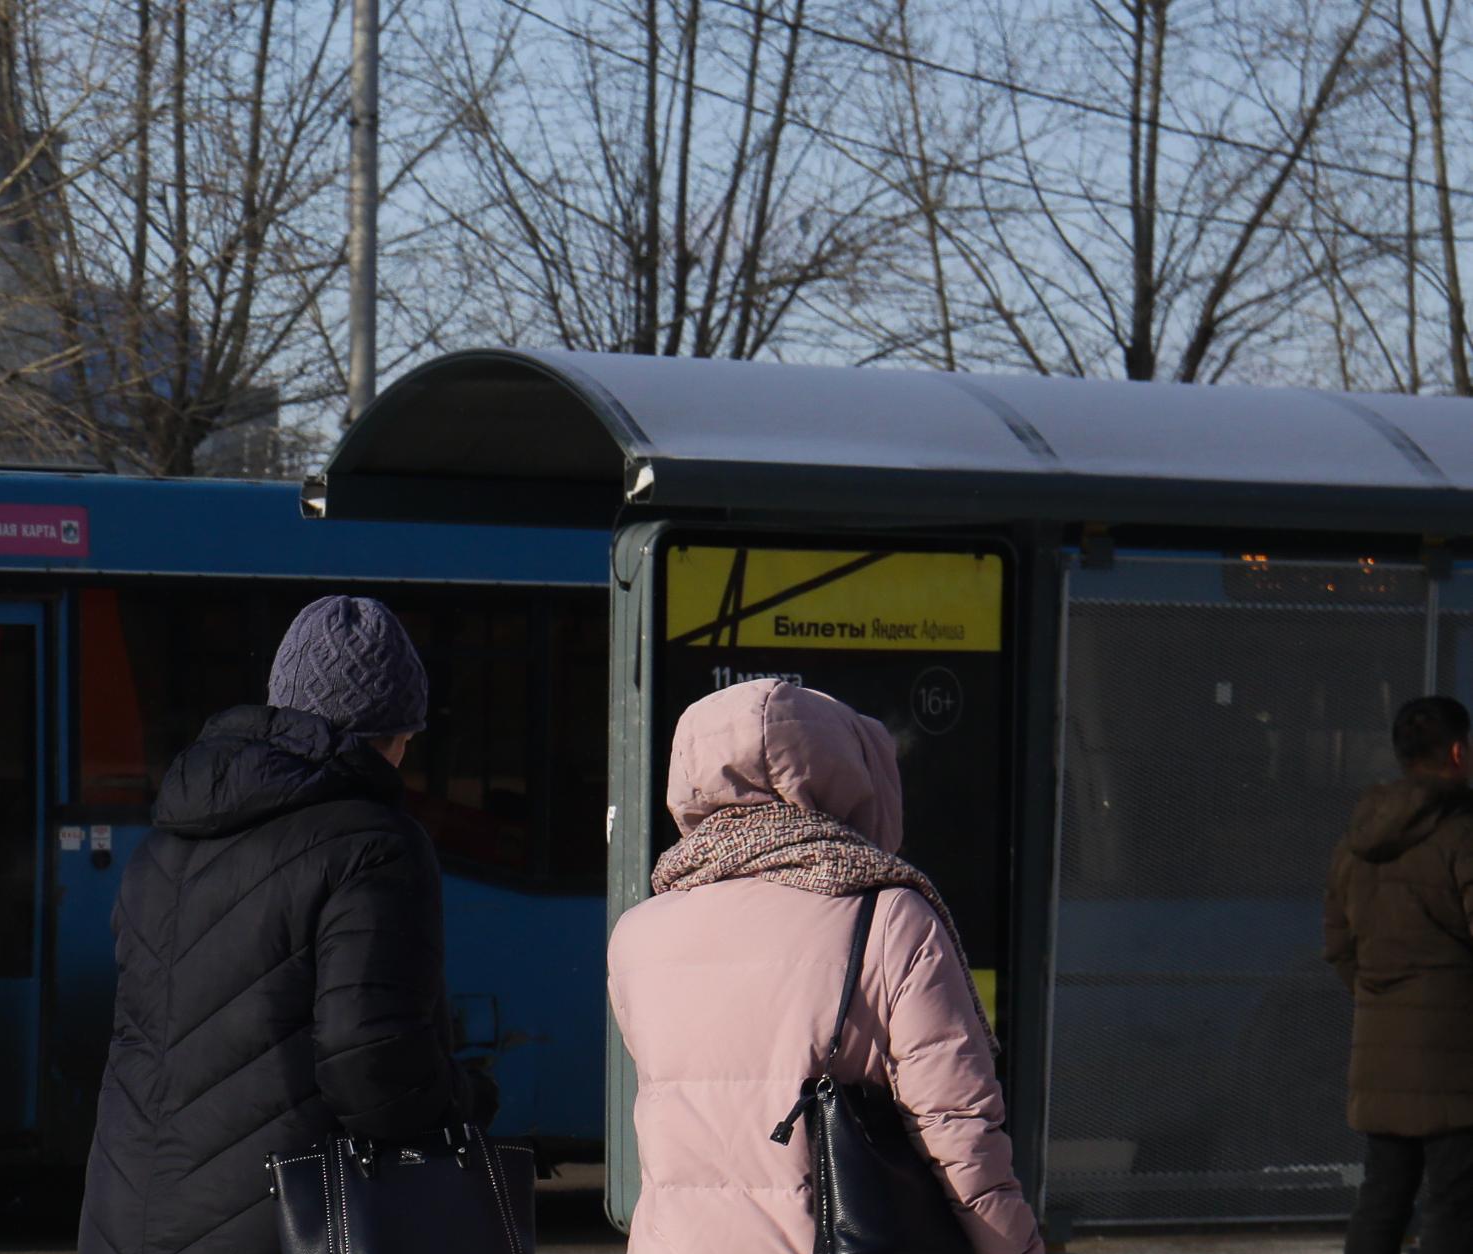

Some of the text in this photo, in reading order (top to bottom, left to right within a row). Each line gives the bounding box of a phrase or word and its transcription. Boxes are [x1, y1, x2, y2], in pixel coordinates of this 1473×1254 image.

[21, 524, 58, 539] КАРТА
[773, 615, 866, 638] Билеты
[871, 616, 916, 640] Яндекс
[711, 666, 731, 688] 11
[917, 687, 955, 715] 16+
